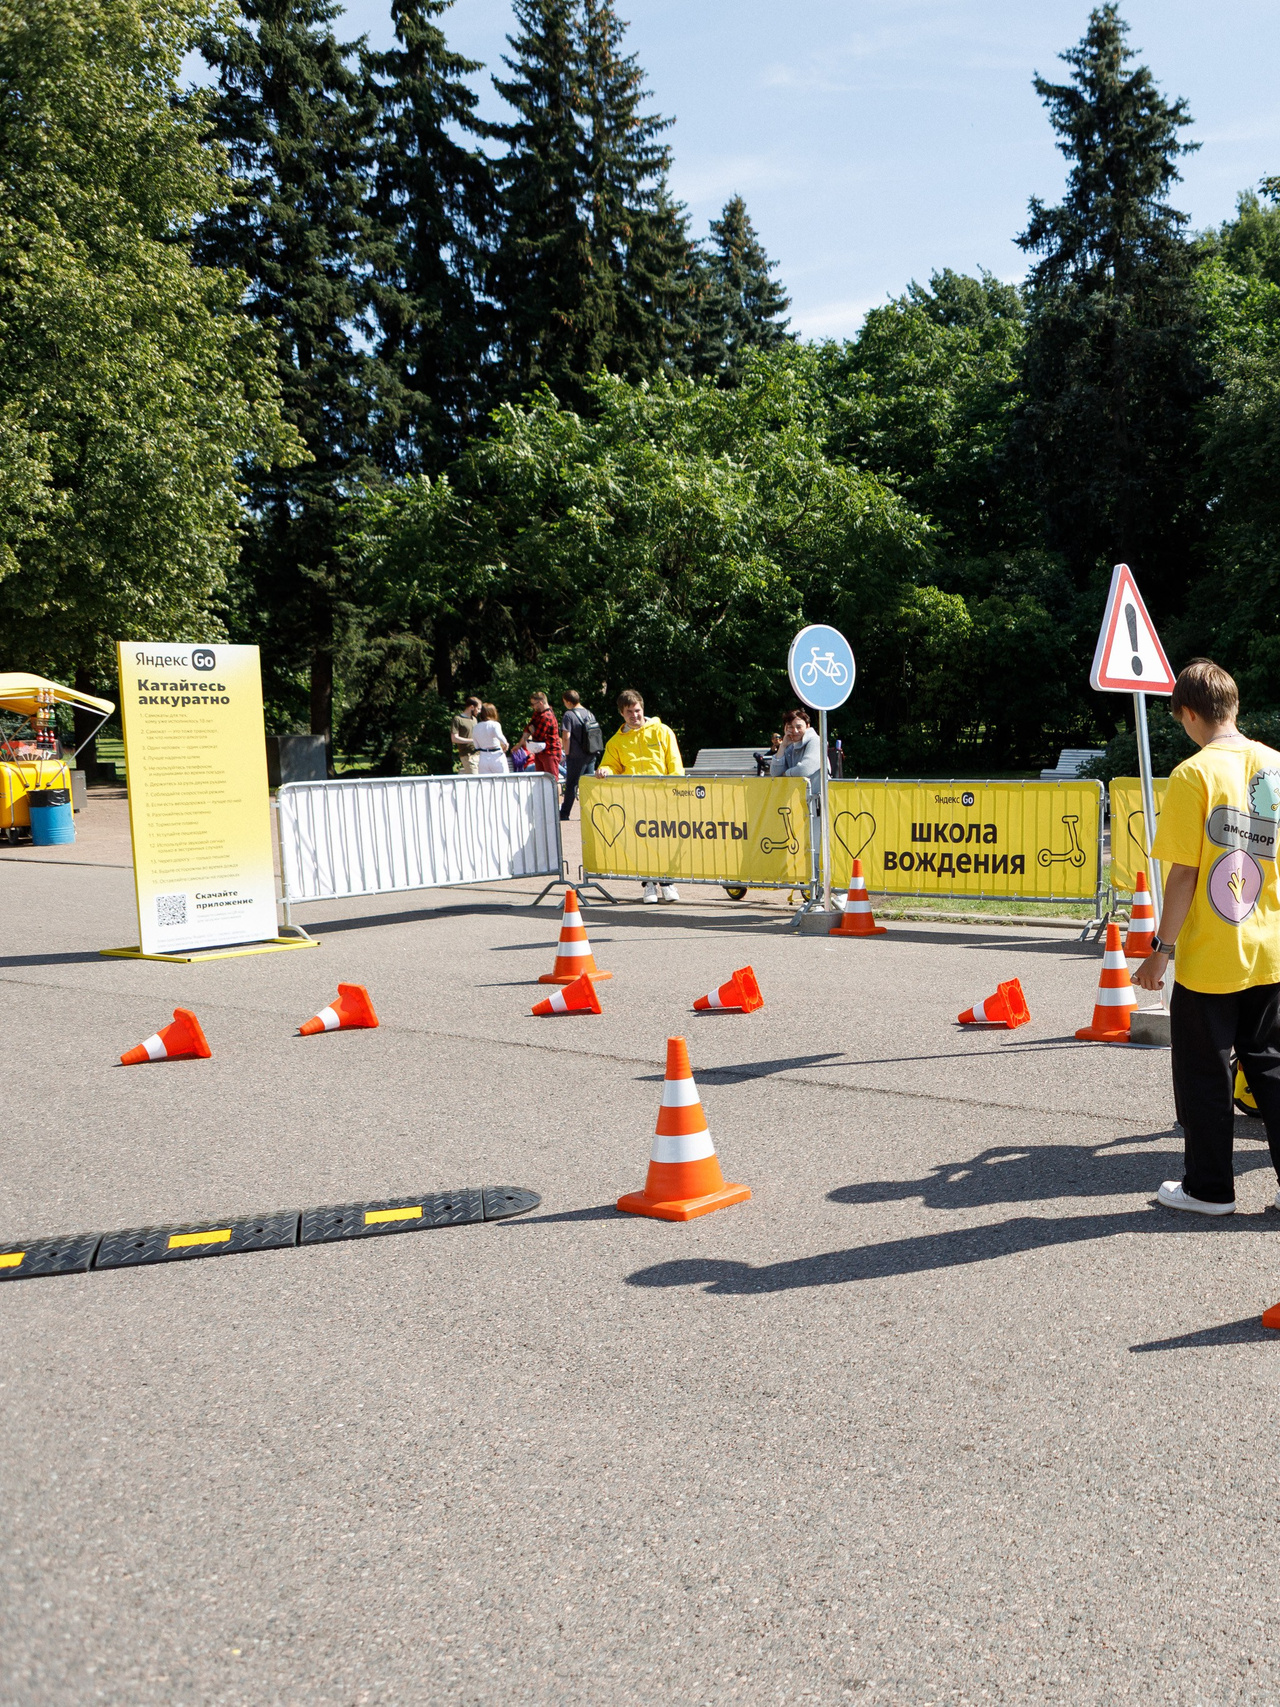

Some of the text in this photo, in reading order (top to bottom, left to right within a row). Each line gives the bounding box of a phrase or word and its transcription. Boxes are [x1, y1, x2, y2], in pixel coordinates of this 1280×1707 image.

[136, 652, 214, 668] Яндекс Go
[138, 679, 226, 691] Катайтесь
[139, 696, 230, 707] аккуратно
[672, 788, 694, 797] Яндекс
[934, 795, 960, 804] Яндекс
[635, 820, 748, 840] самокаты
[911, 823, 997, 844] школа
[1223, 823, 1275, 846] амссадор
[884, 851, 1025, 878] вождения
[195, 890, 238, 900] Скачайте
[196, 898, 254, 910] приложение
